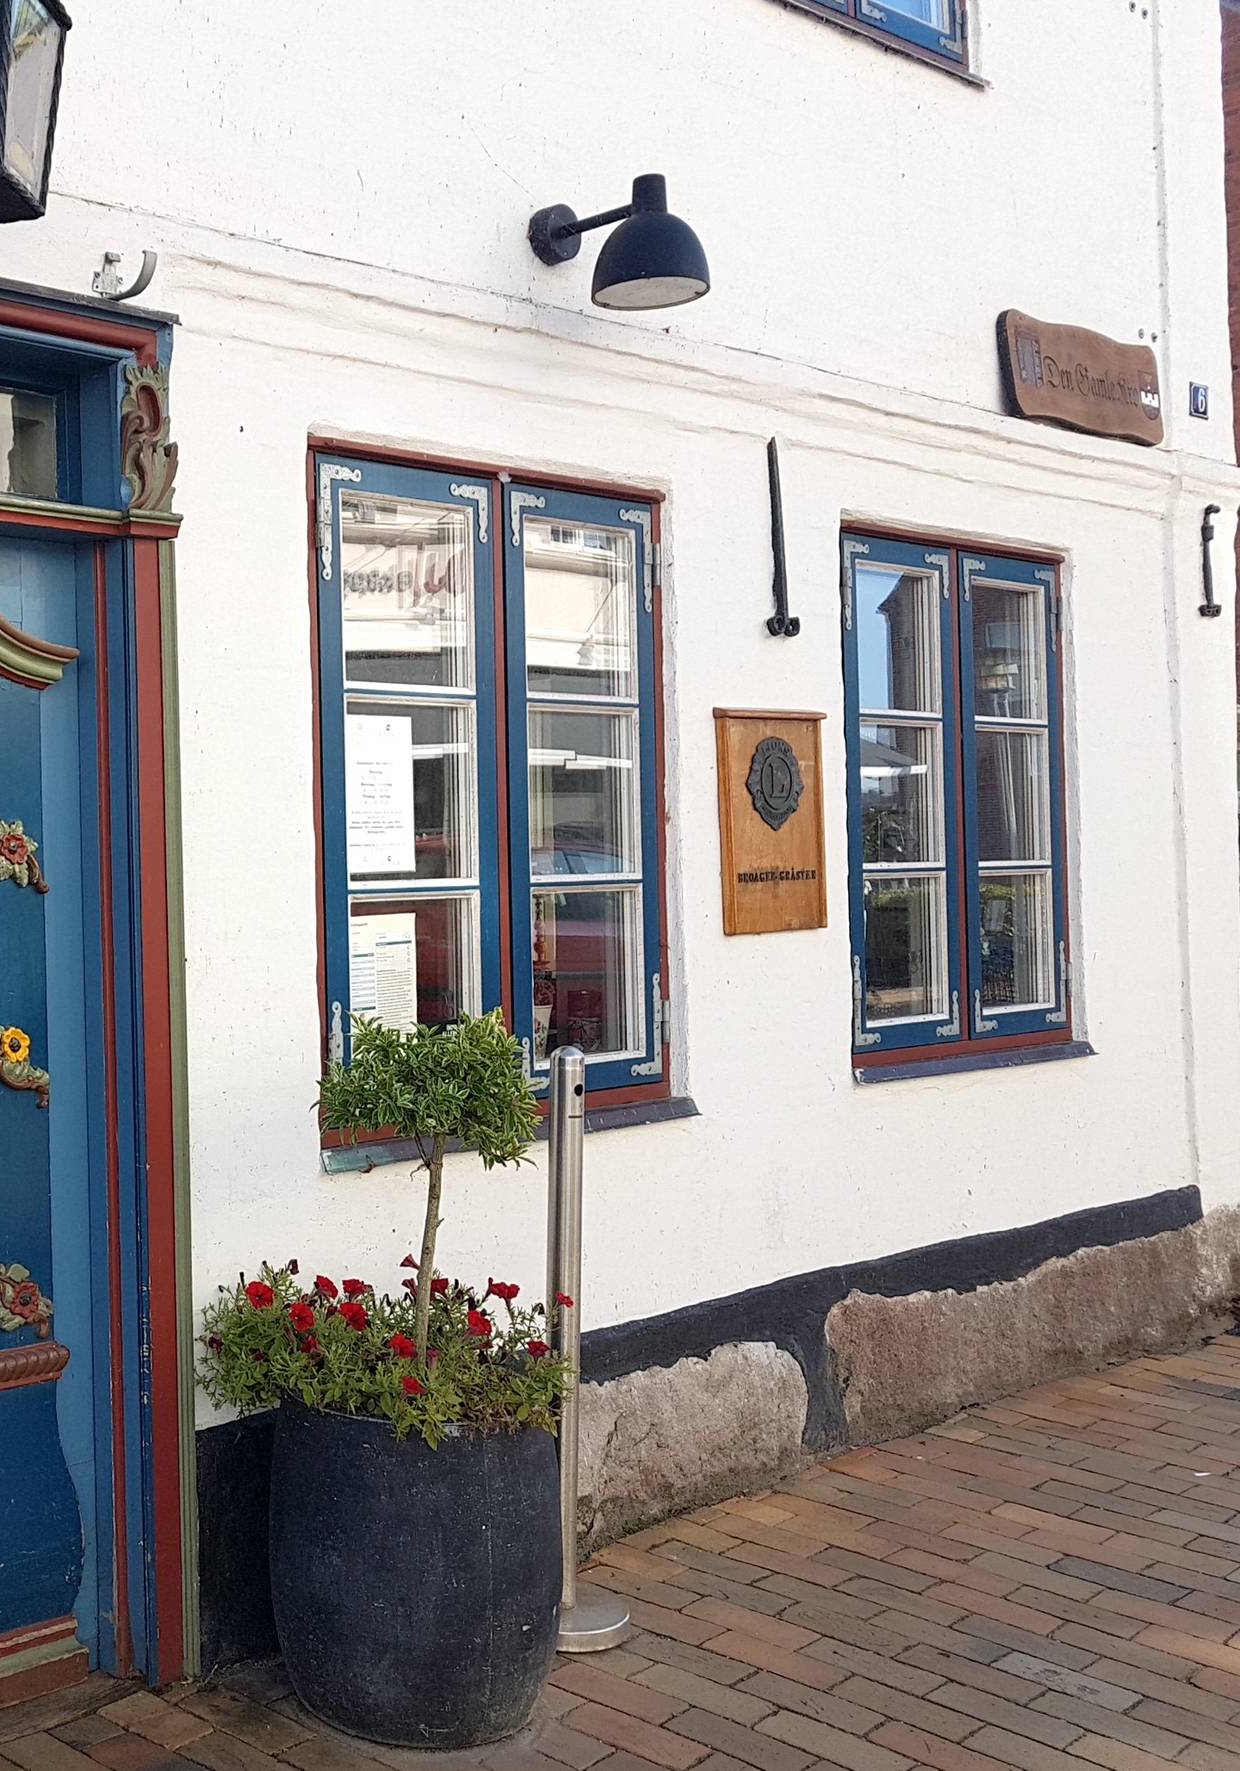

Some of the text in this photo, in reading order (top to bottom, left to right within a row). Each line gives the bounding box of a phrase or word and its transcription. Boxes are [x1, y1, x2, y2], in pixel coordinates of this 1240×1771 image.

[1043, 355, 1074, 390] Den
[1075, 363, 1117, 401] Gamle
[1198, 388, 1207, 412] 6
[768, 762, 786, 799] L
